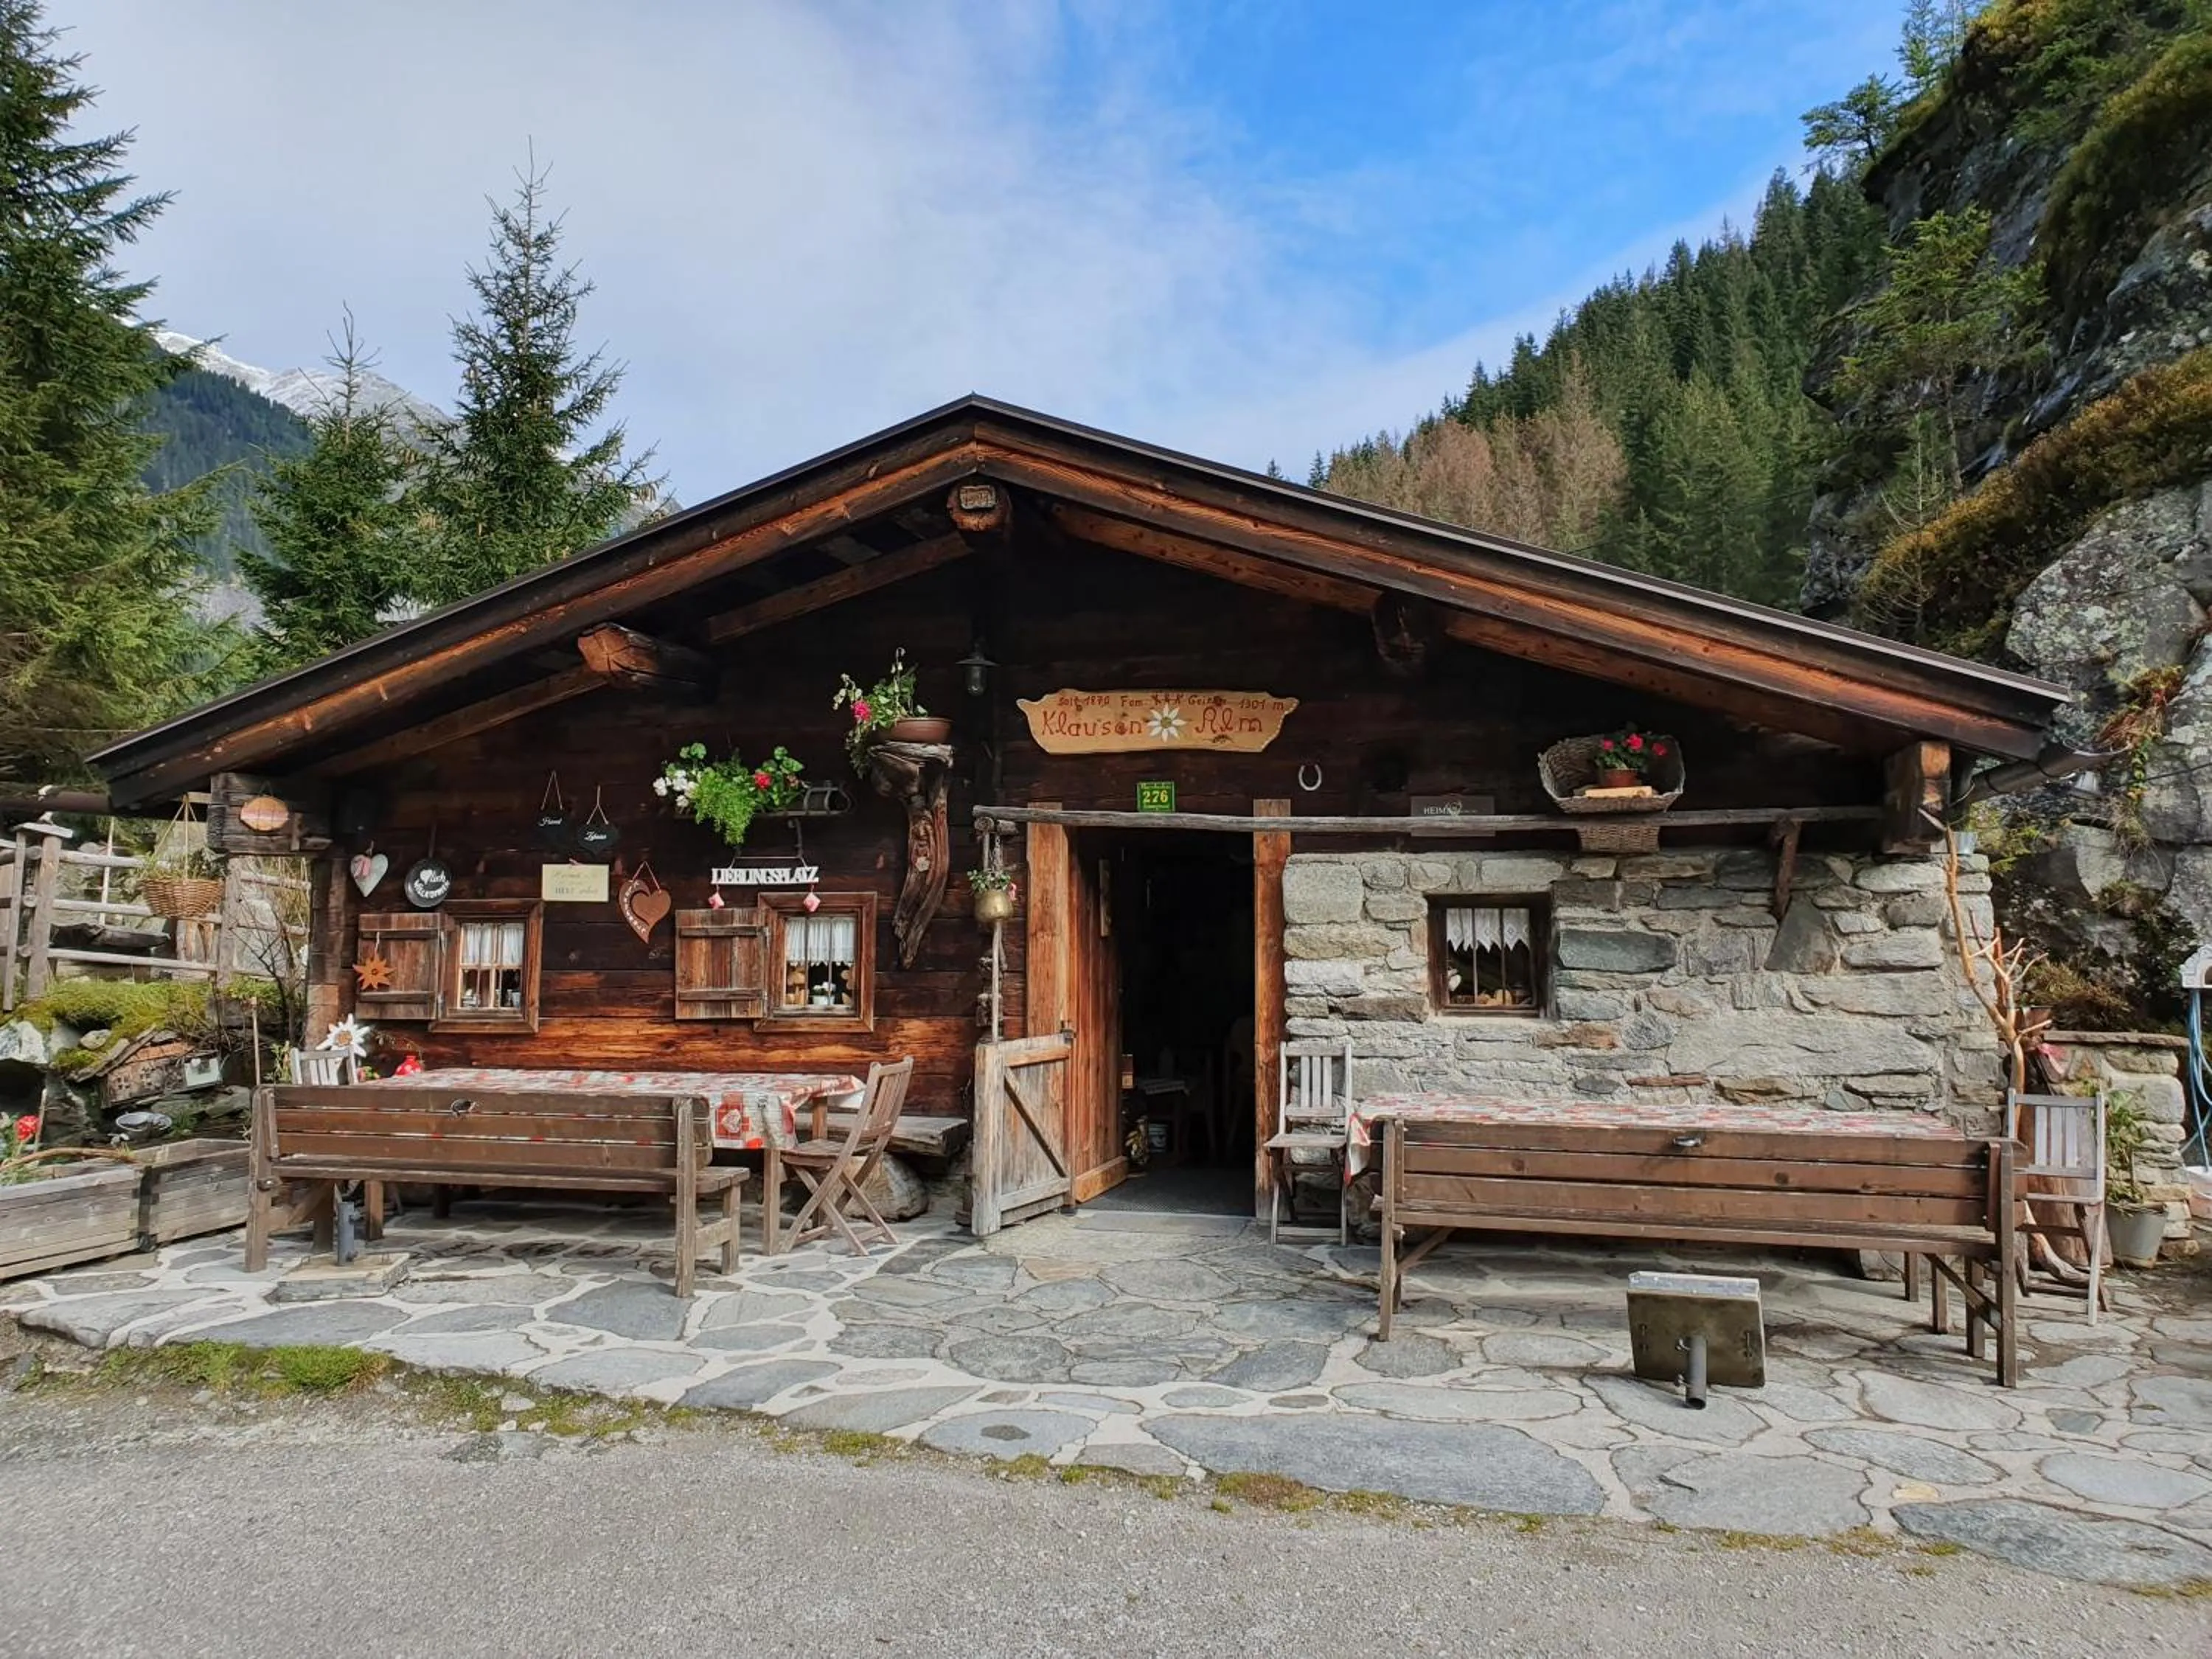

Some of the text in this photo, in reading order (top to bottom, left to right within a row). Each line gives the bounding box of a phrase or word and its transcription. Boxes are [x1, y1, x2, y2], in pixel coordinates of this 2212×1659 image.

[1042, 706, 1262, 737] Klausen Alm
[1143, 790, 1169, 803] 276
[711, 866, 819, 885] LIEBLINGSPLATZ
